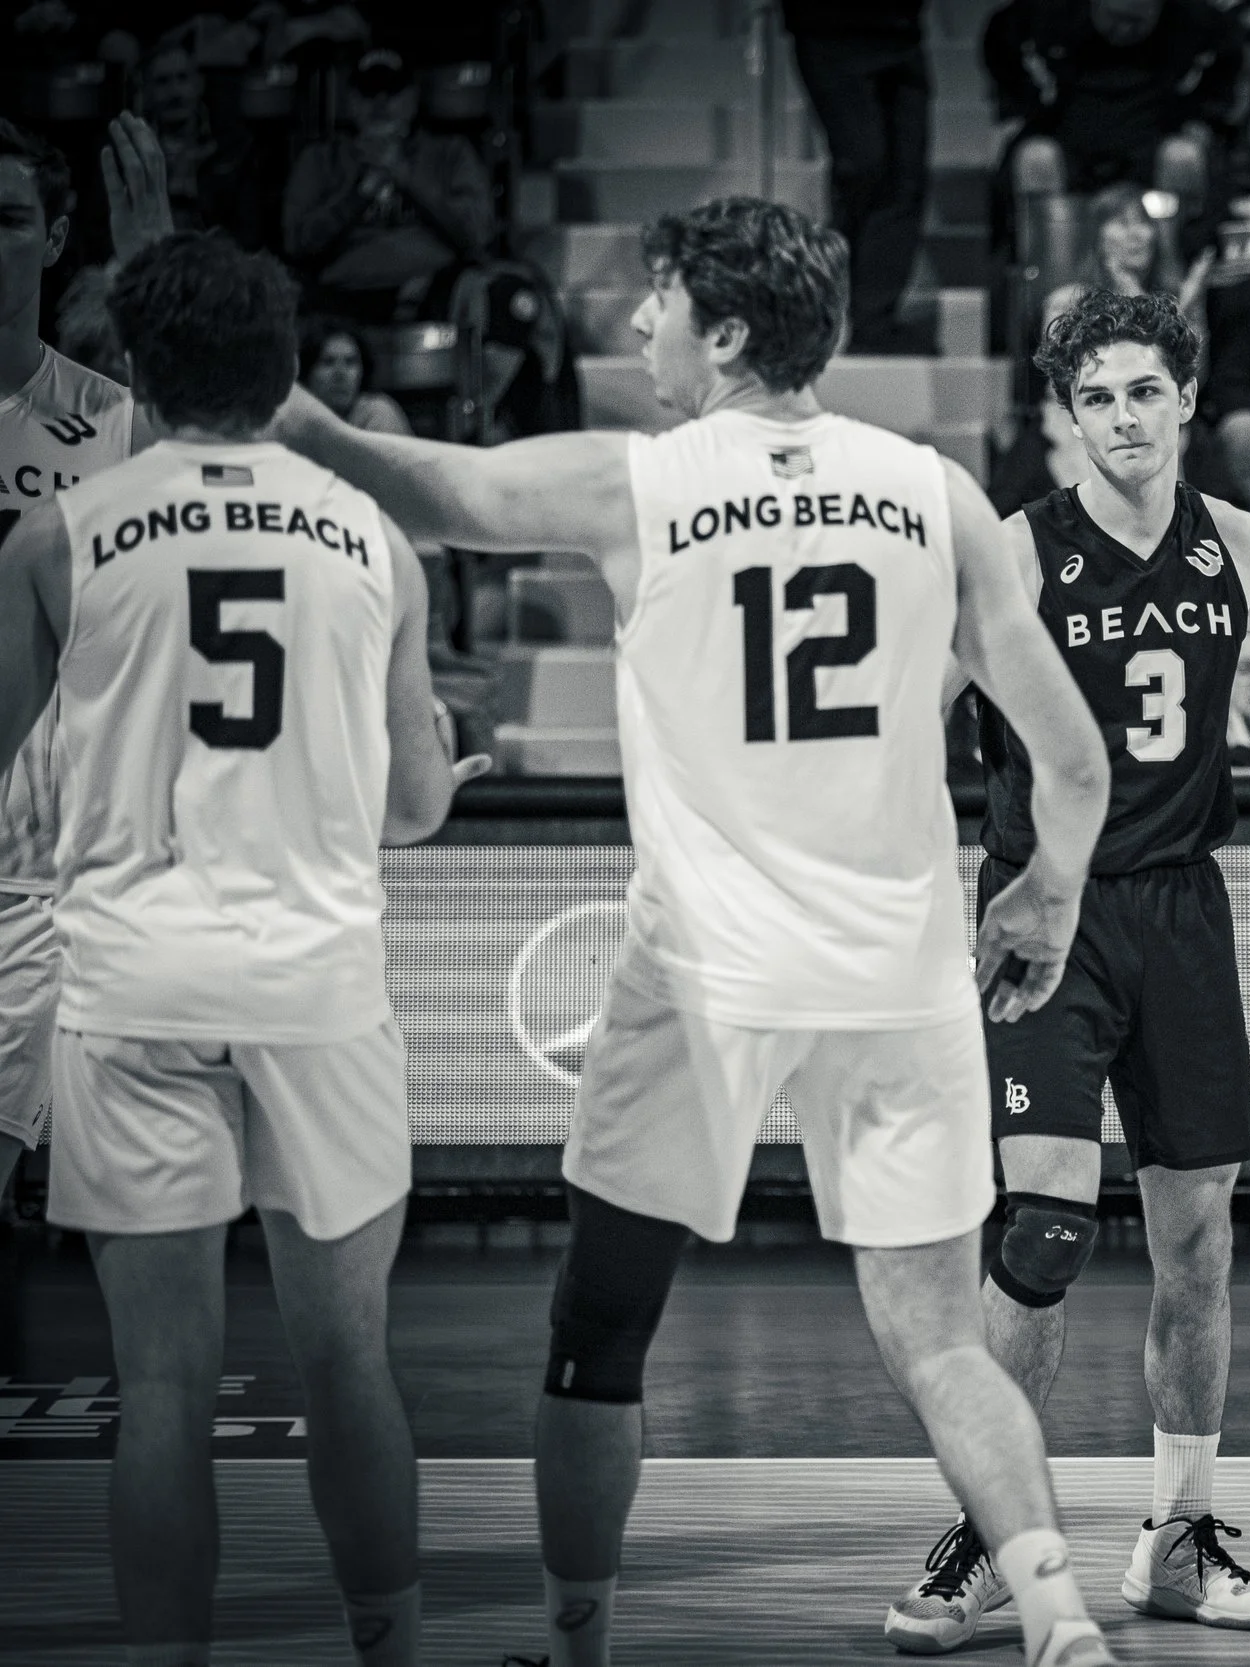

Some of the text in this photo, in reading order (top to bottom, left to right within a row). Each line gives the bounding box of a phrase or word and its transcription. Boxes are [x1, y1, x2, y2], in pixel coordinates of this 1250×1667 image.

[92, 502, 212, 569] LONG
[225, 503, 370, 567] BEACH
[668, 494, 927, 554] LONG BEACH
[187, 568, 285, 751] 5
[733, 562, 879, 743] 12
[1066, 602, 1233, 647] BEACH
[1125, 648, 1187, 762] 3
